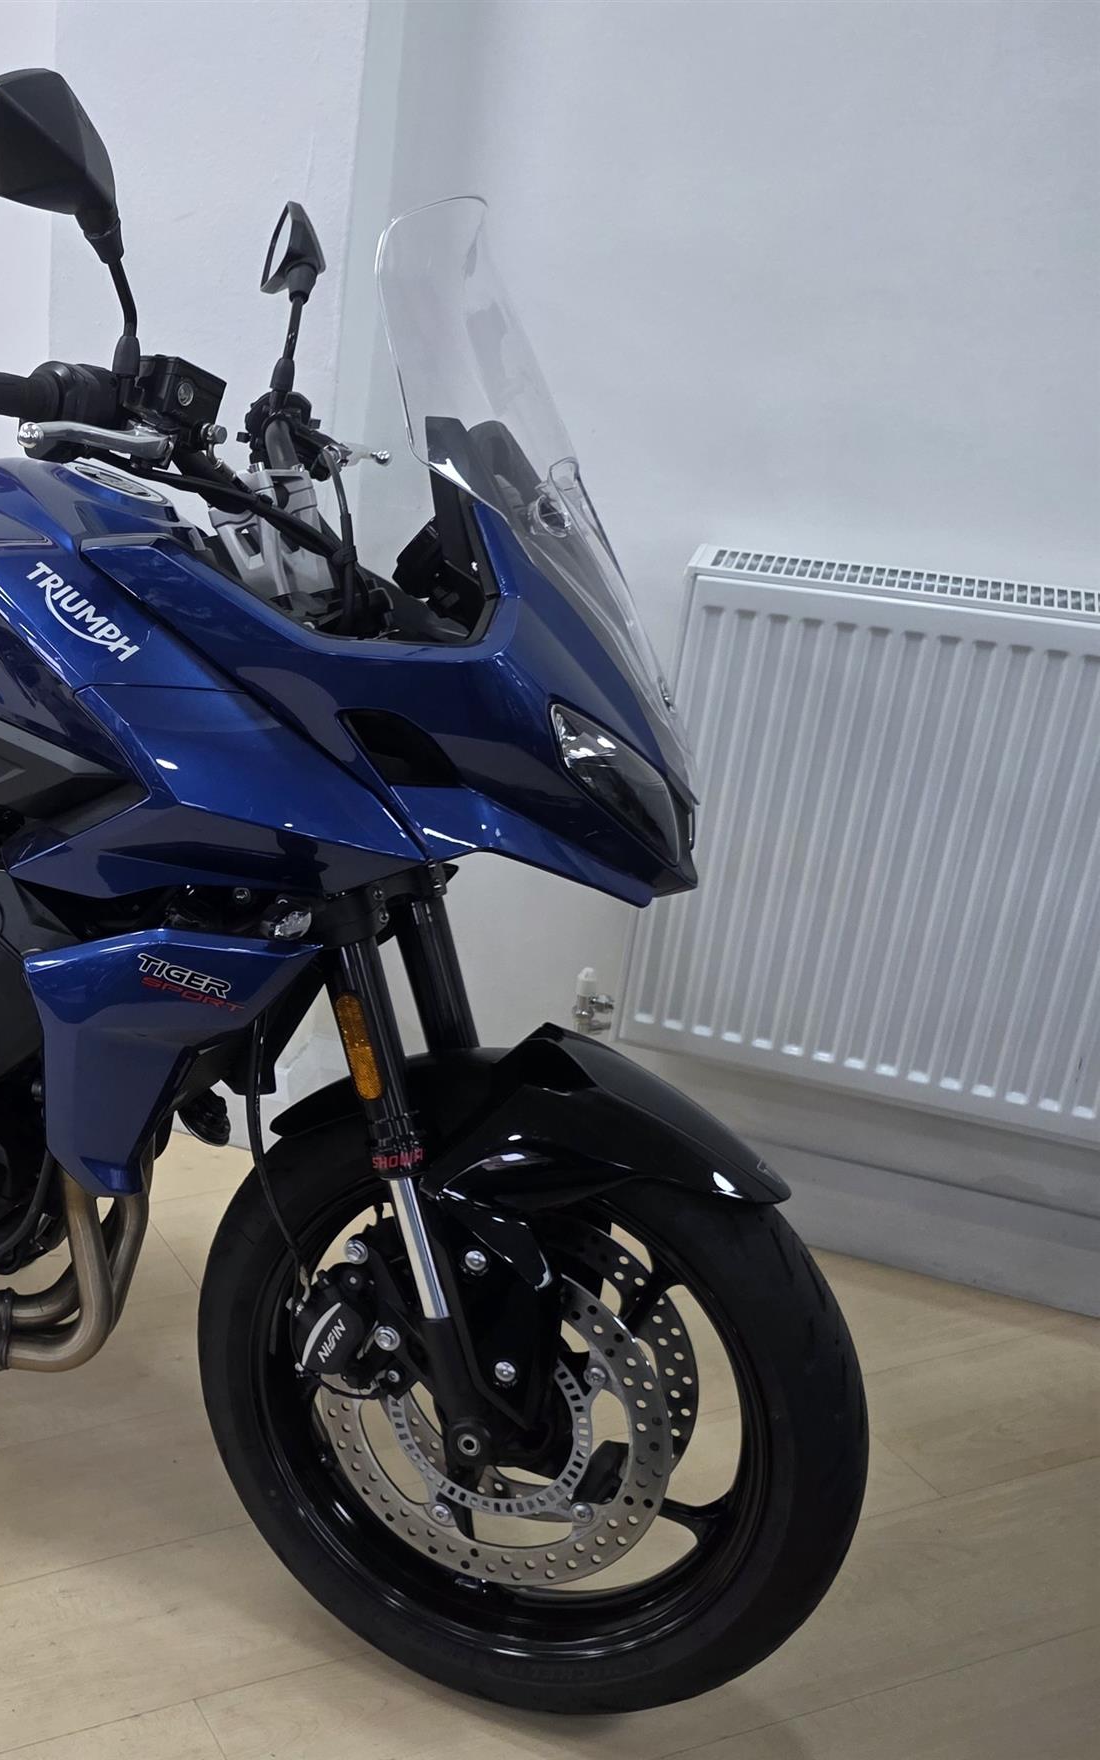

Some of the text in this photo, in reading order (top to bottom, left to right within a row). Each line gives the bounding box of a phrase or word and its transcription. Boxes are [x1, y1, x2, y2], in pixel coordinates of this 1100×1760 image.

[26, 561, 141, 662] TRIUMPH
[137, 952, 232, 999] TIGER
[140, 975, 245, 1012] SPORT
